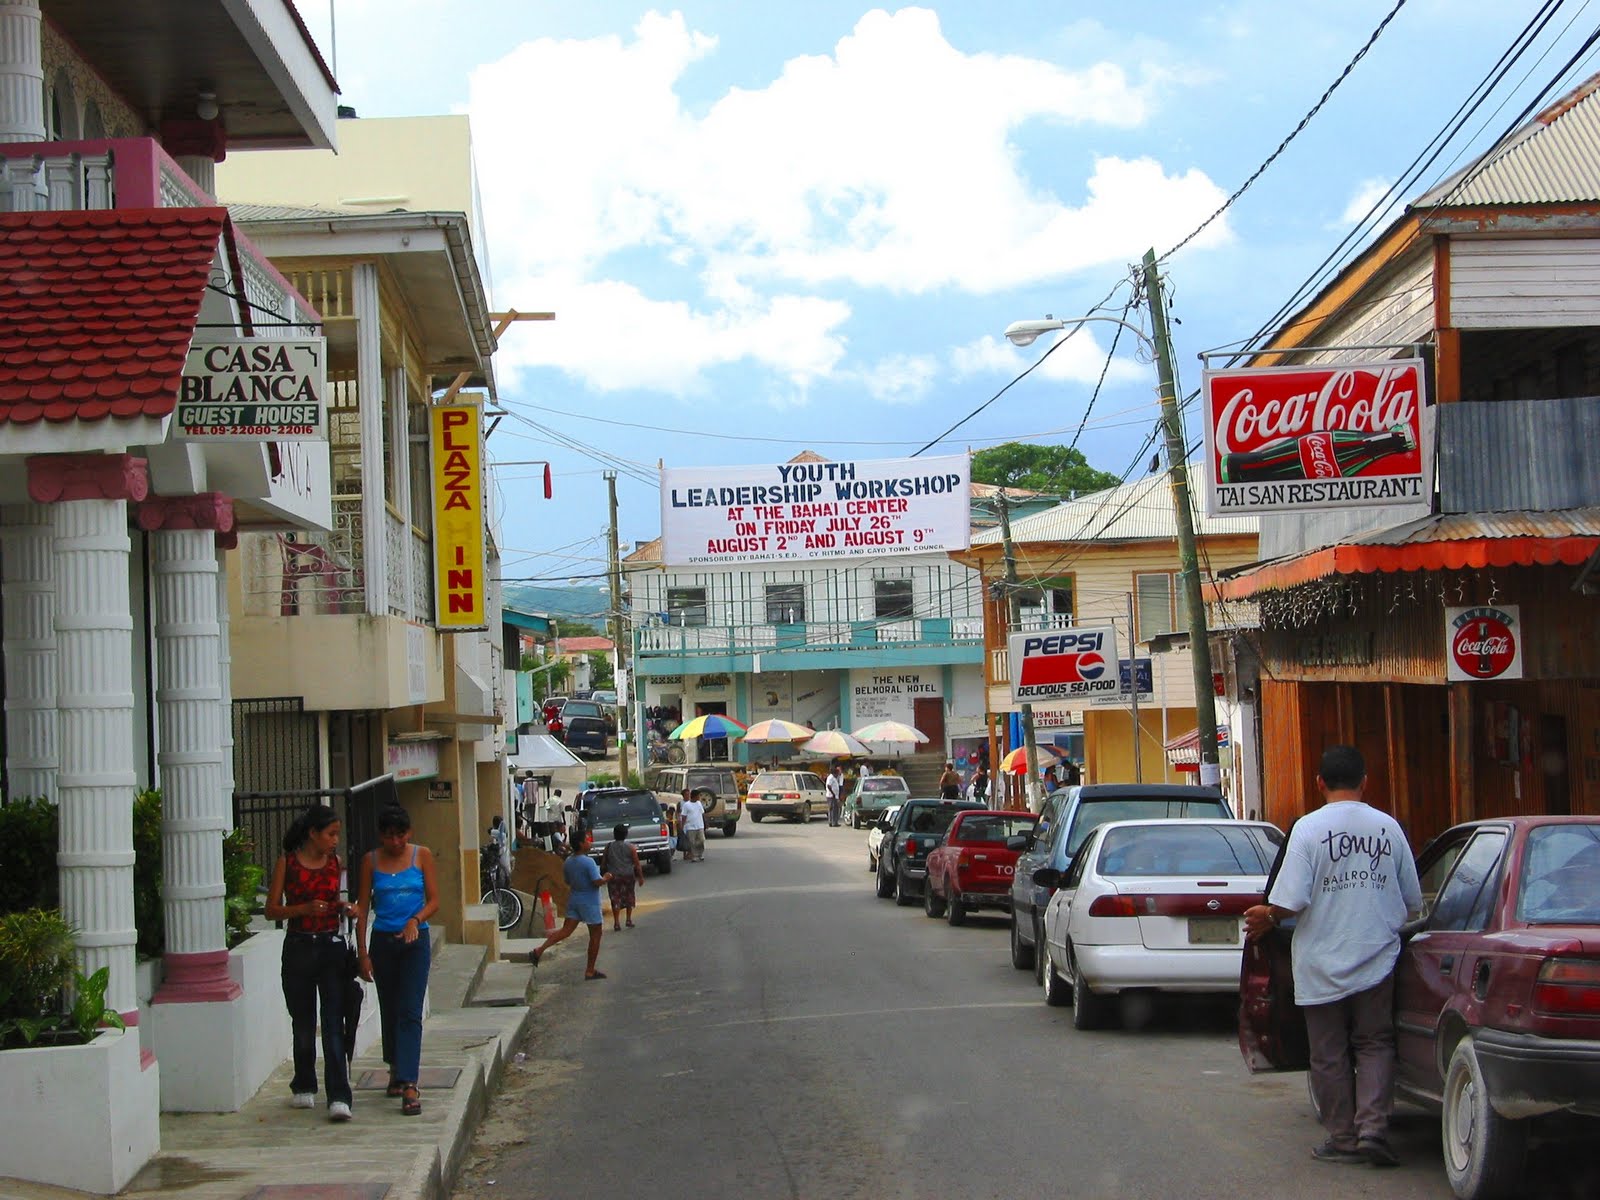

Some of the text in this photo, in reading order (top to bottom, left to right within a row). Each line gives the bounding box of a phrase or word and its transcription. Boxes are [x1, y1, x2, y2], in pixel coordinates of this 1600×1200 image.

[204, 345, 294, 372] CASA
[180, 375, 318, 402] BLANCA
[183, 406, 317, 425] GUEST HOUSE
[1215, 368, 1415, 456] Coca-Cola
[442, 411, 471, 511] PLAZA
[777, 463, 855, 483] YOUTH
[671, 474, 960, 507] LEADERSHIP WORKSHOP
[1216, 477, 1422, 506] TAI SAN RESTAURANT
[727, 507, 744, 520] AT
[753, 506, 784, 520] THE
[846, 498, 908, 515] CENTER
[736, 522, 756, 536] ON
[764, 520, 816, 535] FRIDAY
[826, 517, 861, 532] JULY
[707, 537, 768, 554] AUGUST
[805, 534, 835, 549] AND
[844, 530, 904, 547] AUGUST
[688, 555, 734, 563] SPONSORED
[448, 546, 473, 613] INN
[1024, 632, 1103, 656] PEPSI
[1457, 636, 1509, 656] Coca-Cola
[855, 684, 936, 695] BELMORAL HOTEL
[873, 675, 919, 684] THE NEW
[1018, 683, 1067, 697] DELICIOUS
[1070, 679, 1116, 693] SEAFOOD
[1038, 718, 1065, 726] STORE
[1321, 827, 1392, 871] tony's
[1323, 870, 1387, 887] BALLROOM
